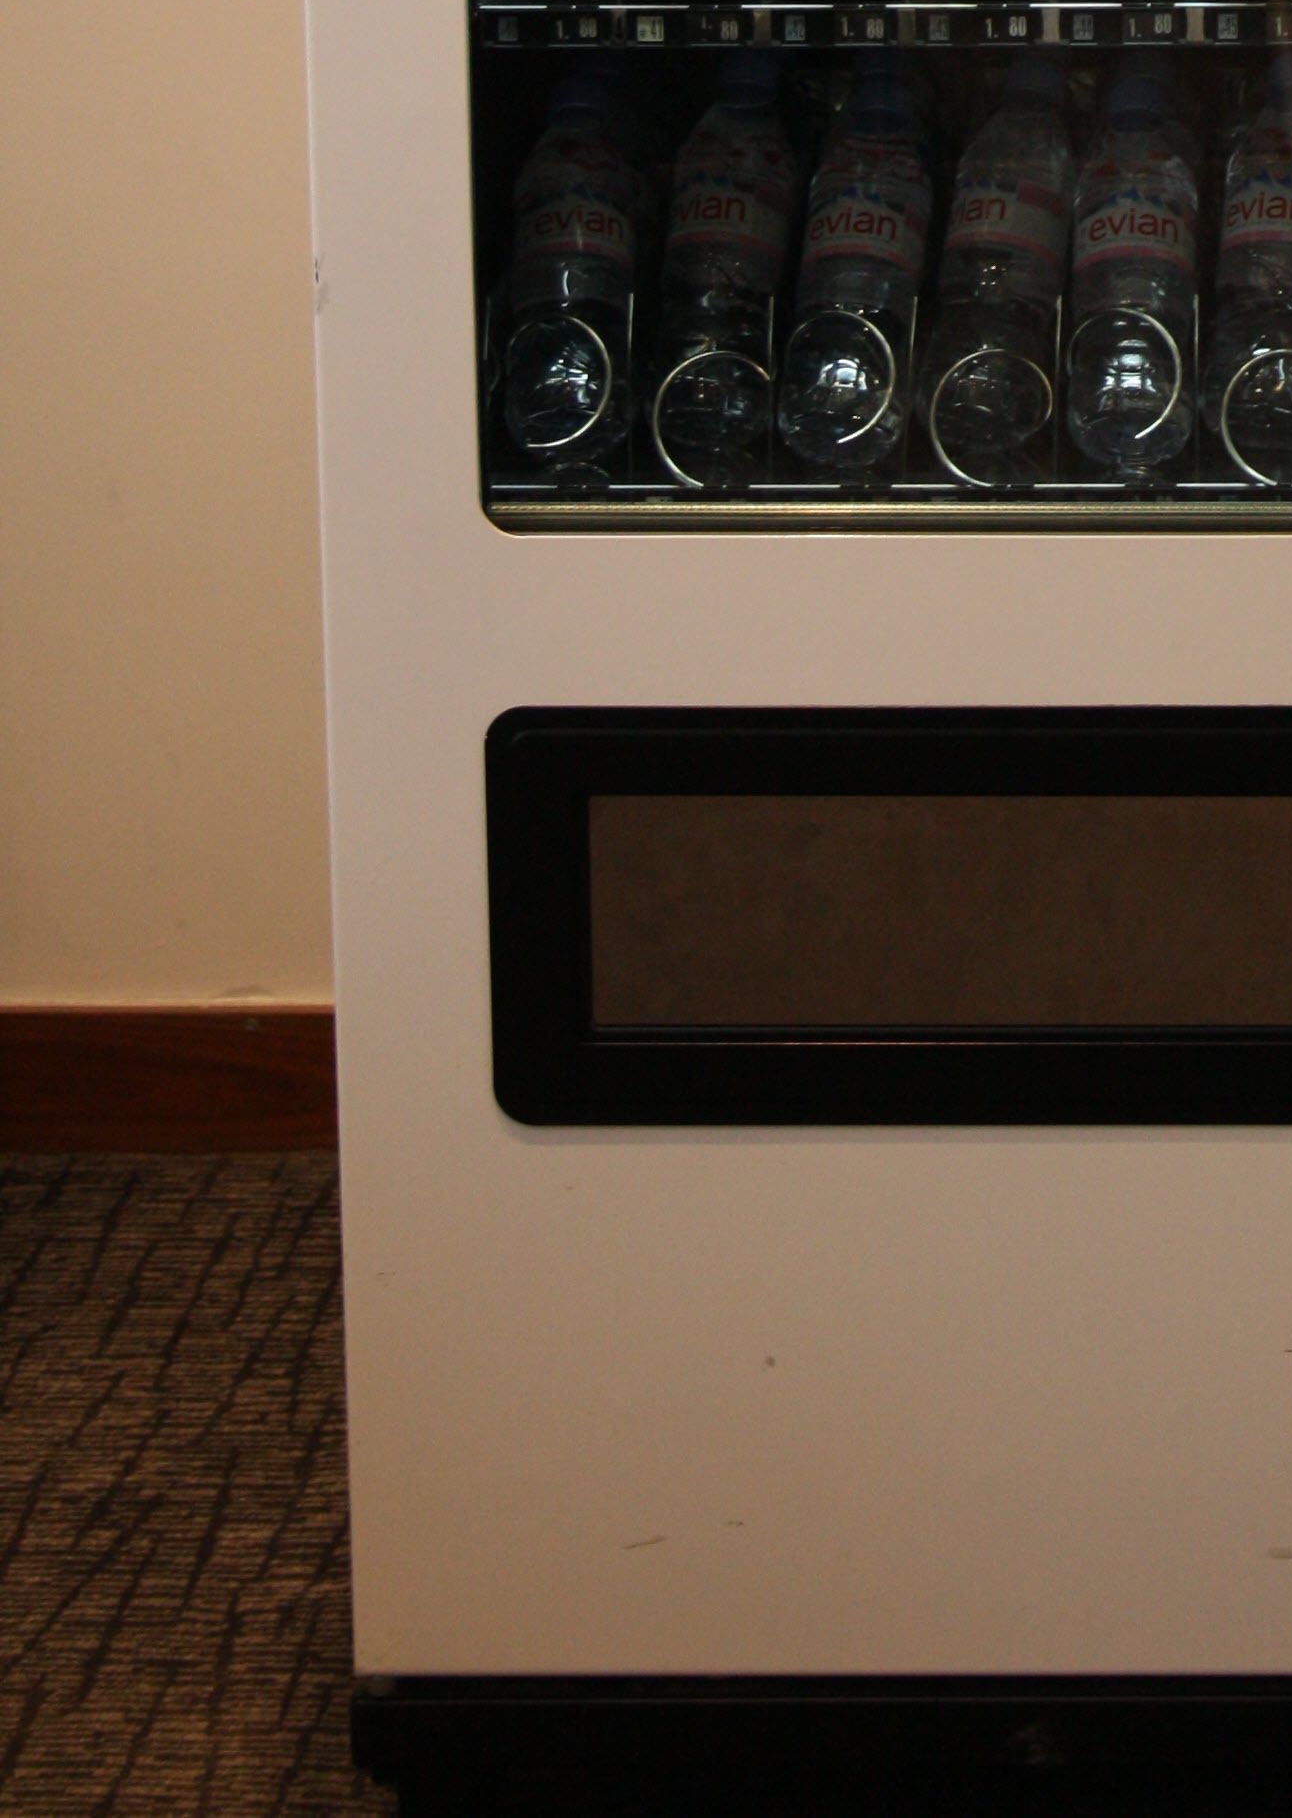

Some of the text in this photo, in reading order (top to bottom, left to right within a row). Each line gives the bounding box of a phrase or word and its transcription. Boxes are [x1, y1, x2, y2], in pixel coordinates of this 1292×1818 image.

[535, 205, 624, 241] evian
[676, 193, 746, 224] vian
[810, 206, 897, 242] evian
[1088, 207, 1179, 243] evian
